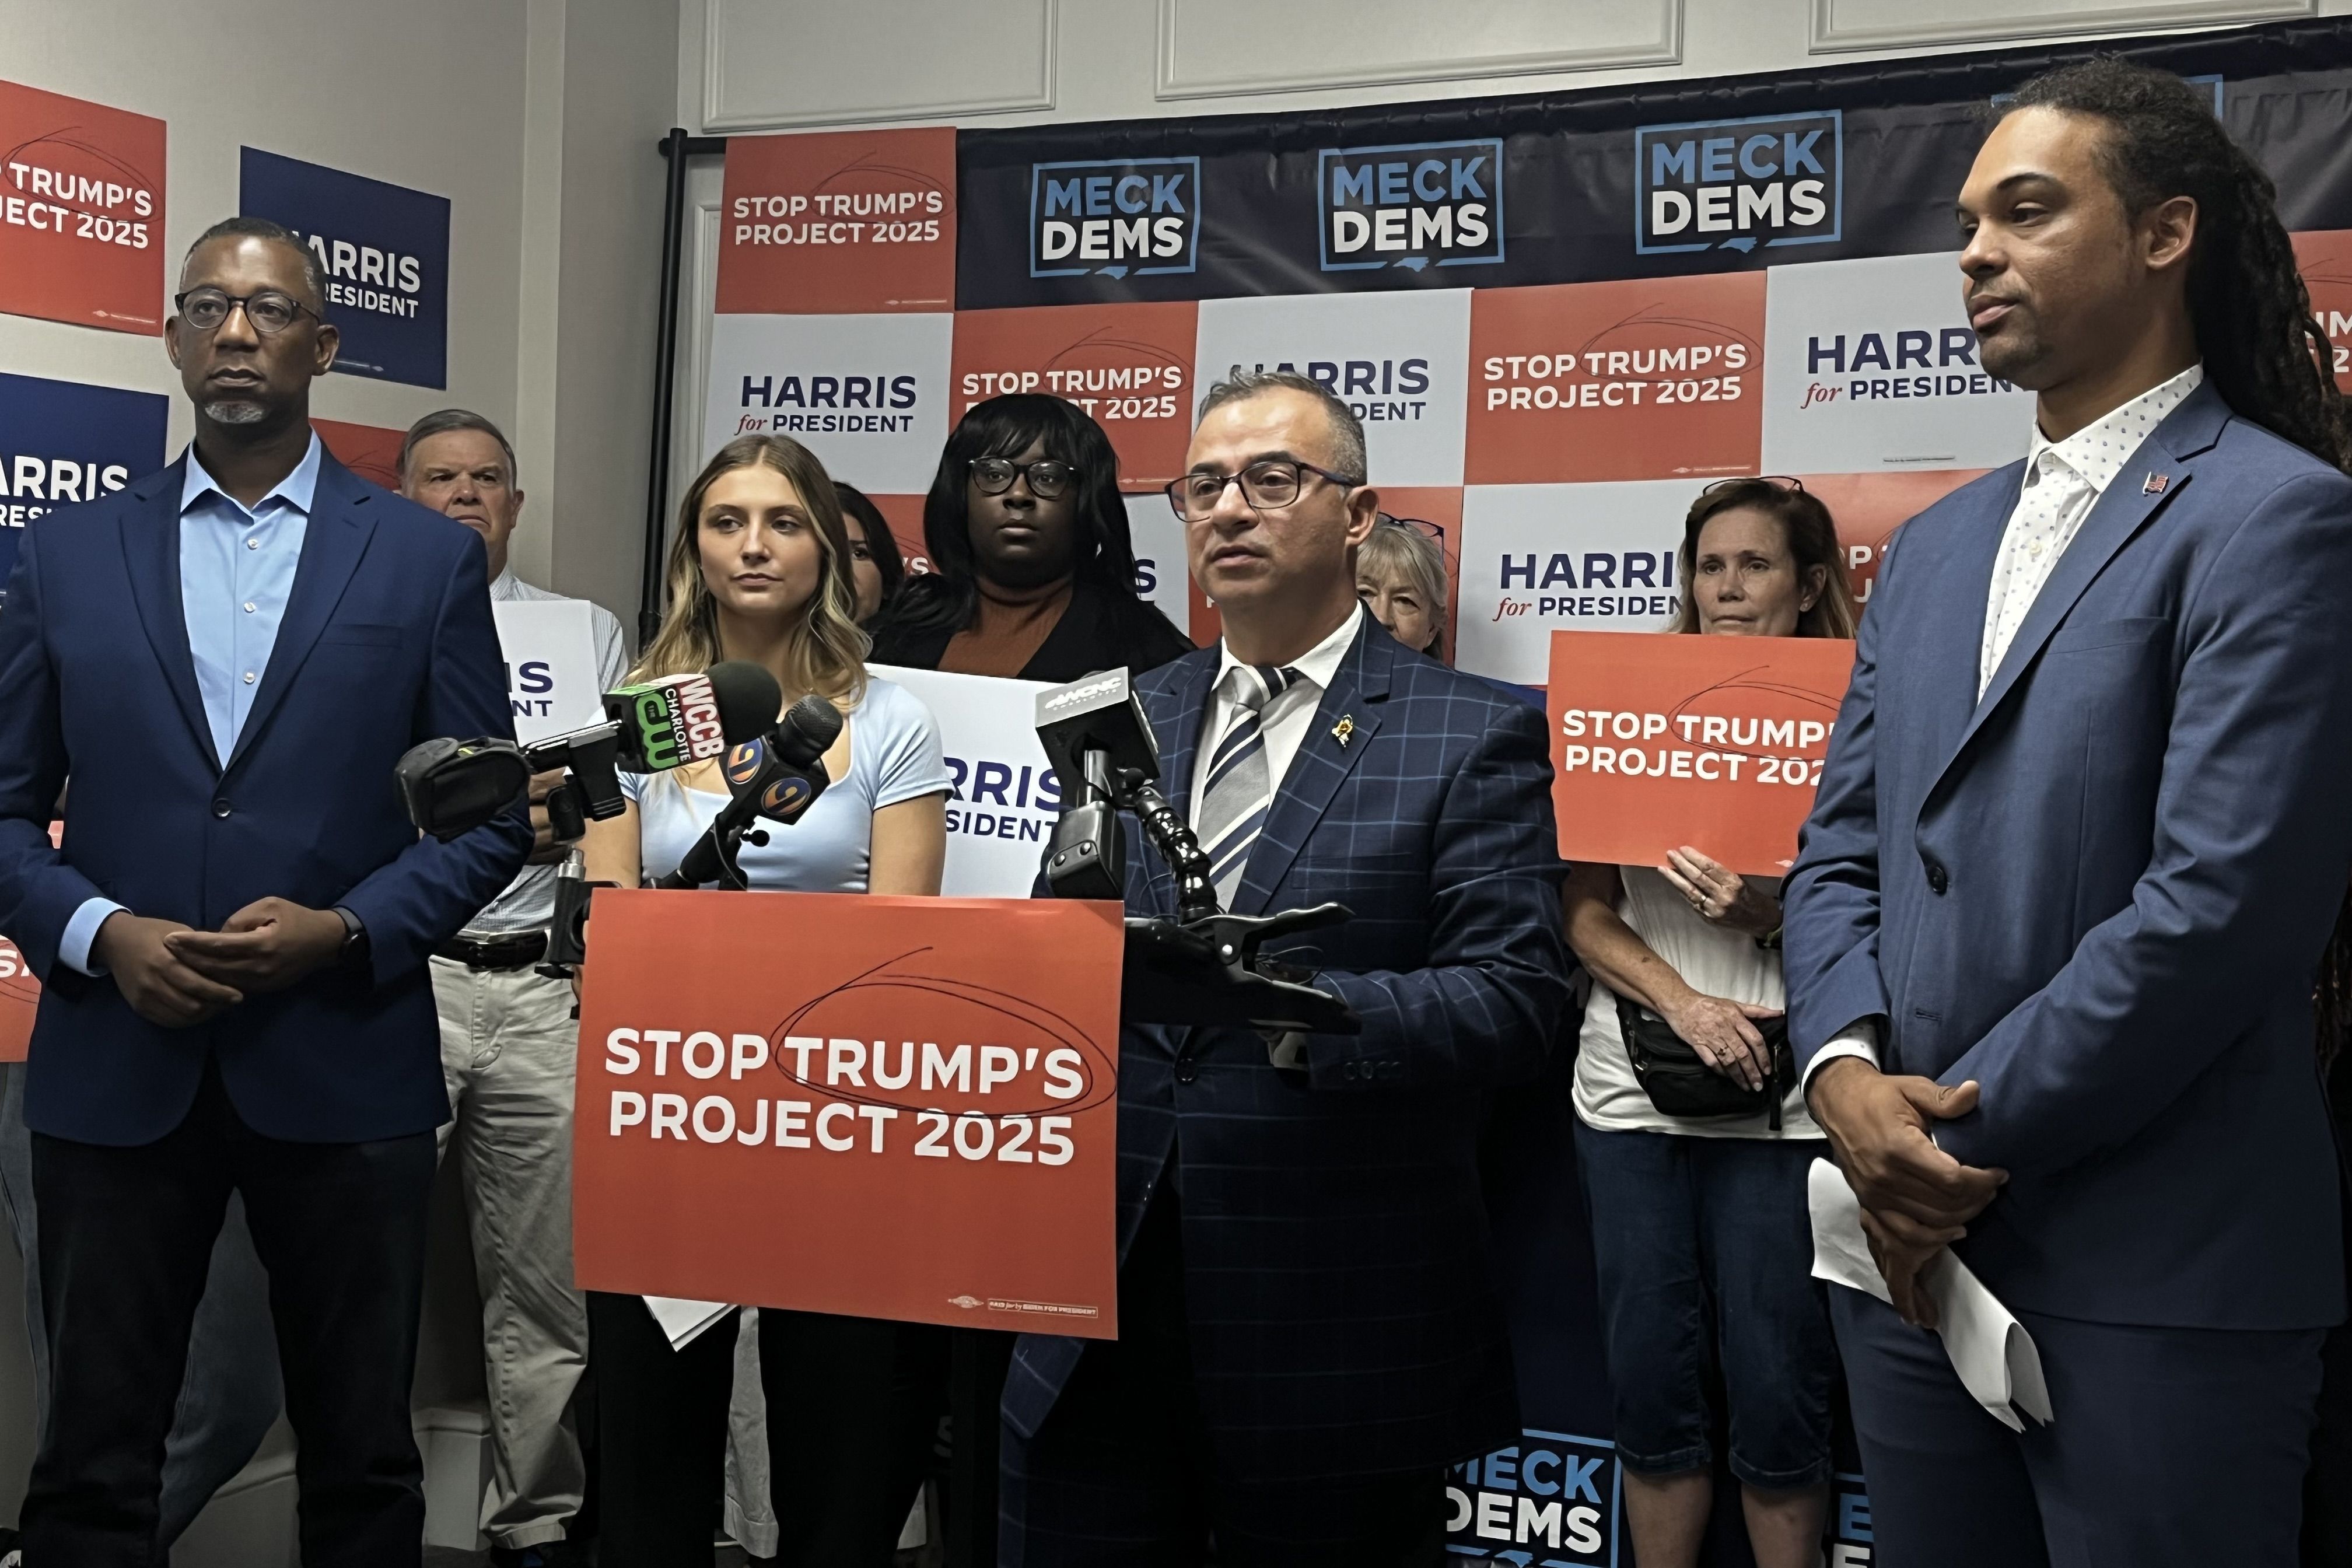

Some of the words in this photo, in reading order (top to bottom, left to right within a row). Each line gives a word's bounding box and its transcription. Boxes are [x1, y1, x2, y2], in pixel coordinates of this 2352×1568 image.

[1653, 131, 1823, 186] MECK
[9, 162, 152, 216] TRUMP'S
[1046, 175, 1183, 215] MECK
[1335, 158, 1485, 205] MECK
[734, 197, 807, 218] STOP
[815, 191, 942, 215] TRUMP'S
[1652, 180, 1826, 235] DEMS
[76, 211, 149, 249] 2025
[736, 223, 866, 245] PROJECT
[873, 220, 939, 242] 2025
[1043, 218, 1183, 260] DEMS
[1334, 203, 1488, 253] DEMS
[292, 231, 420, 293] ARRIS
[326, 282, 418, 318] ESIDENT
[1485, 355, 1576, 380] STOP
[1584, 344, 1746, 375] TRUMP'S
[1808, 328, 1976, 374] HARR
[742, 376, 916, 408] HARRIS
[963, 372, 1038, 394] STOP
[1046, 366, 1181, 392] TRUMP'S
[1231, 359, 1429, 395] RRIS
[1488, 383, 1647, 410] PROJECT
[1657, 376, 1741, 403] 2025
[1801, 383, 1842, 409] for
[1850, 374, 2011, 400] PRESIDEN
[734, 415, 768, 435] for
[774, 415, 913, 432] PRESIDENT
[1106, 396, 1176, 418] 2025
[0, 456, 127, 502] RRIS
[1501, 552, 1673, 589] HARRI
[1493, 597, 1532, 622] for
[1539, 596, 1683, 616] PRESIDEN
[636, 693, 679, 769] CW
[665, 688, 691, 761] CHARLOTTE
[680, 677, 724, 758] WCCB
[1563, 710, 1667, 739] STOP
[1676, 715, 1835, 748] TRUMP'
[1566, 746, 1747, 780] PROJECT
[943, 757, 1060, 811] RRIS
[606, 1028, 768, 1079] STOP
[785, 1037, 1083, 1098] TRUMP'S
[611, 1091, 897, 1153] PROJECT
[915, 1108, 1073, 1165] 2025
